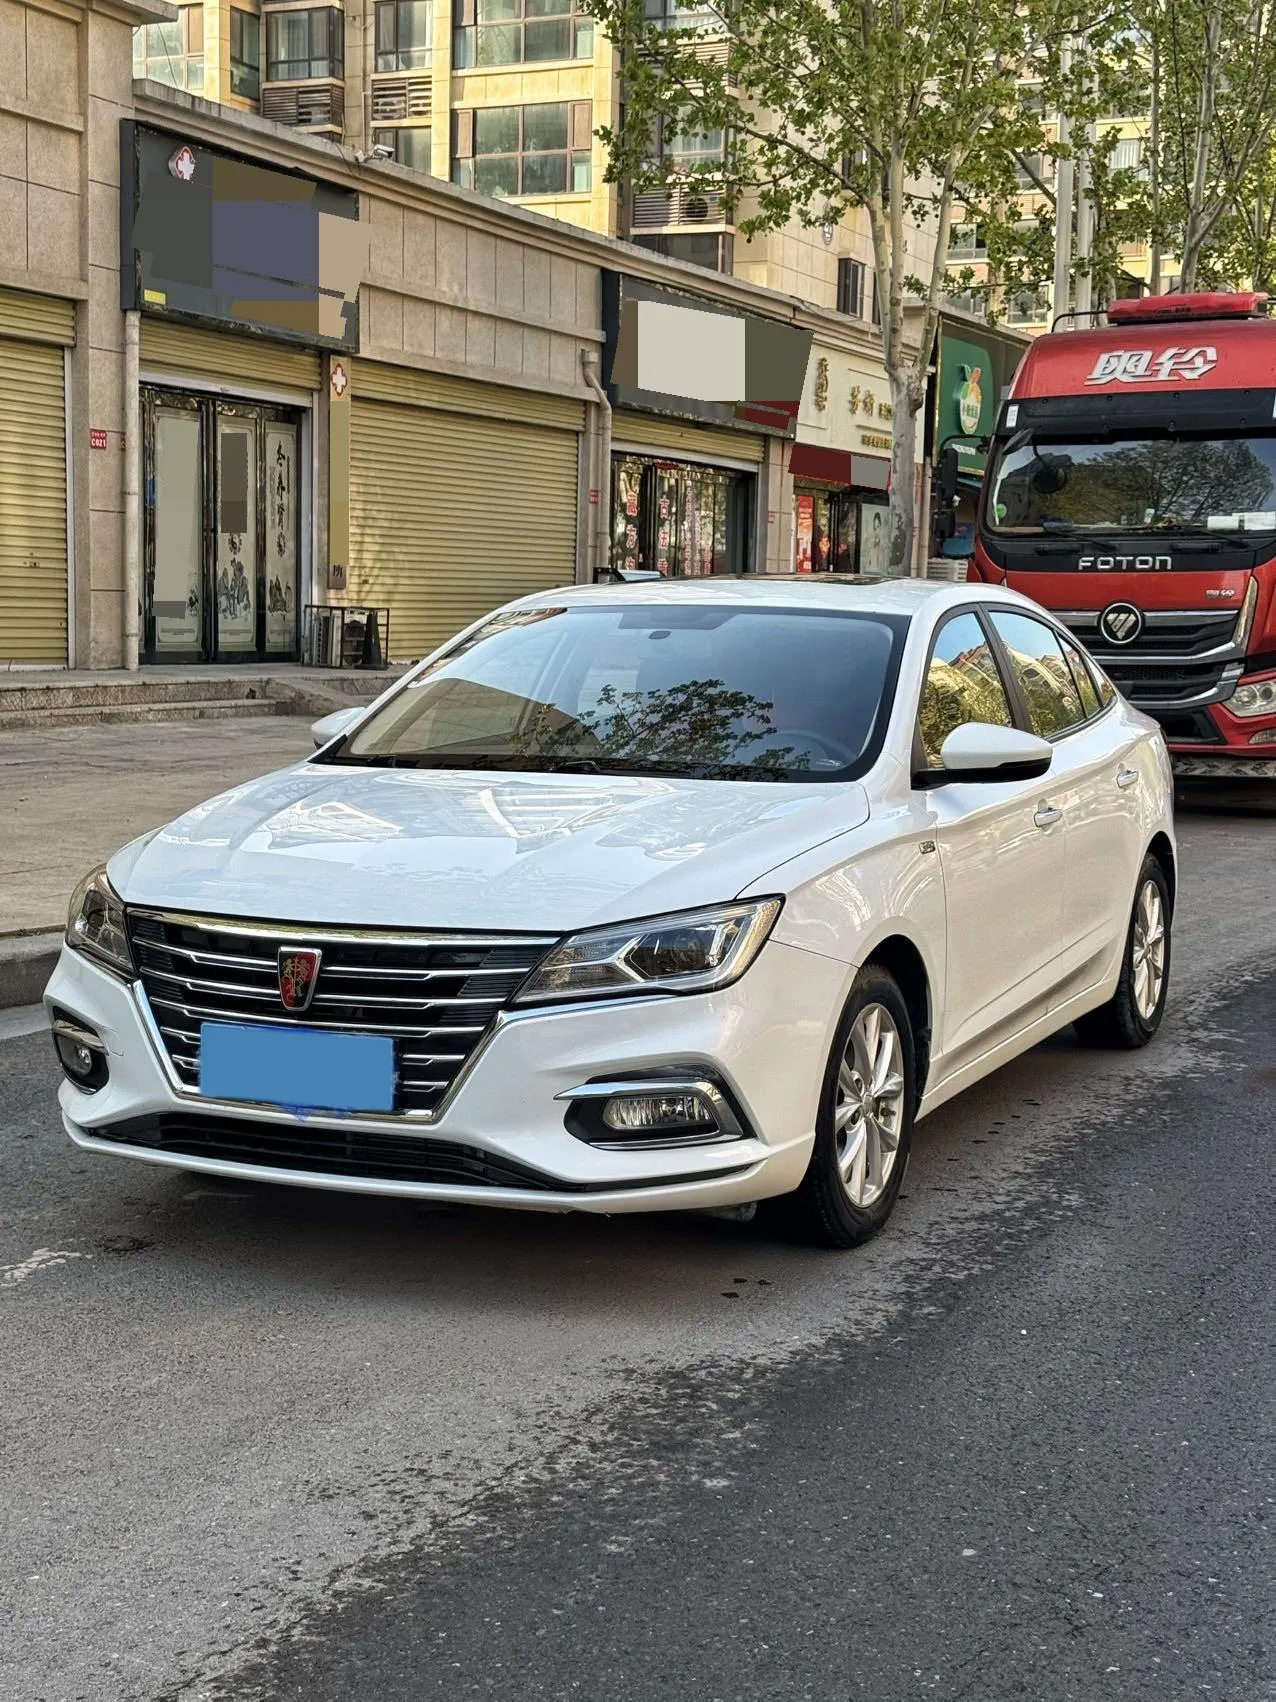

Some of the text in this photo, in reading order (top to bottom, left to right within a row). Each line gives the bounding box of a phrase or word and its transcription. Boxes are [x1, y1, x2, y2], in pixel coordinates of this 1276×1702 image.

[1084, 346, 1218, 386] 奥铃
[91, 438, 106, 447] C021
[1078, 556, 1172, 570] FOTON
